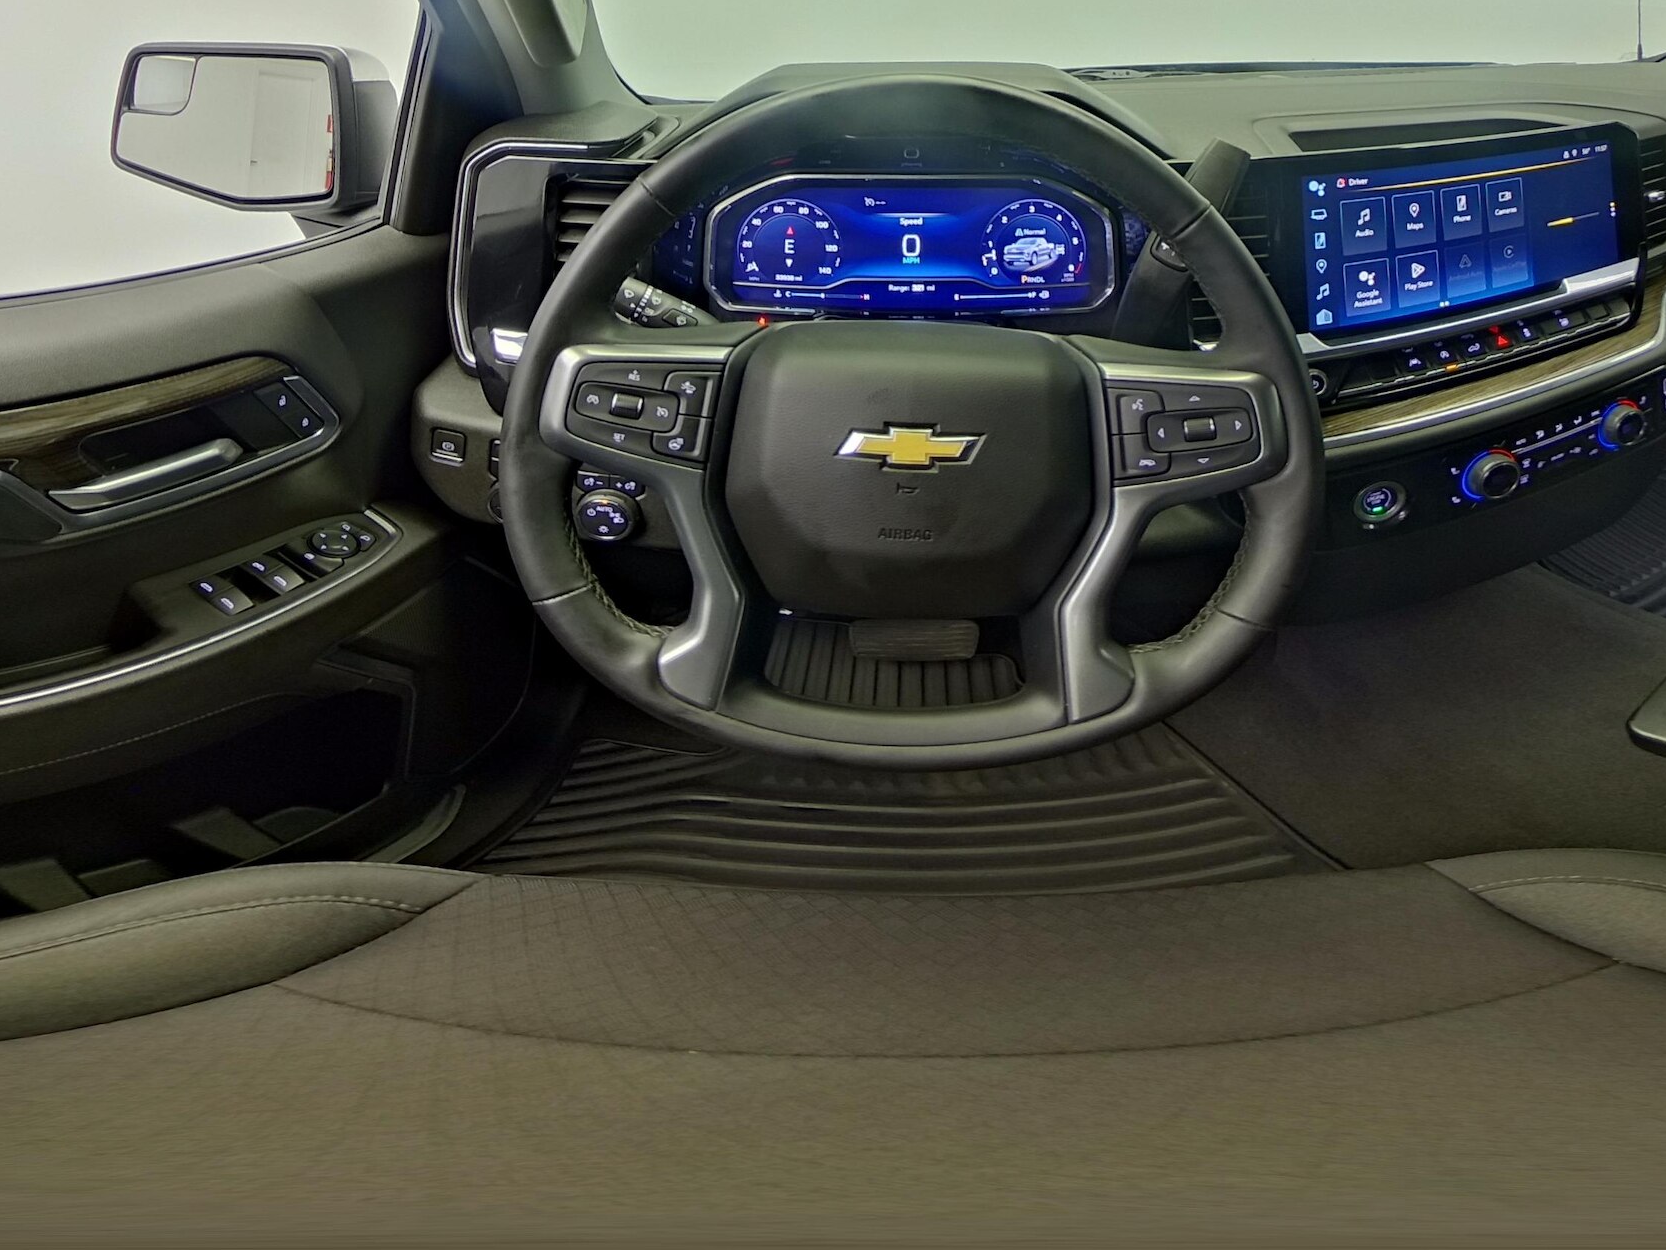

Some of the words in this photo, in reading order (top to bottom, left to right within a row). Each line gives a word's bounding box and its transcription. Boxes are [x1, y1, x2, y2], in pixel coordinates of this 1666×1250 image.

[1349, 178, 1368, 186] Driver
[1494, 207, 1517, 215] Cameras
[899, 217, 923, 226] Speed
[1453, 215, 1471, 223] Phone
[816, 221, 829, 229] 100
[784, 239, 795, 253] E
[902, 234, 921, 257] 0
[1417, 280, 1433, 288] Store
[888, 284, 910, 293] Range:
[1357, 290, 1379, 298] Google
[1354, 298, 1382, 308] Assistant
[628, 373, 640, 381] RES
[878, 528, 933, 541] AIRBAG
